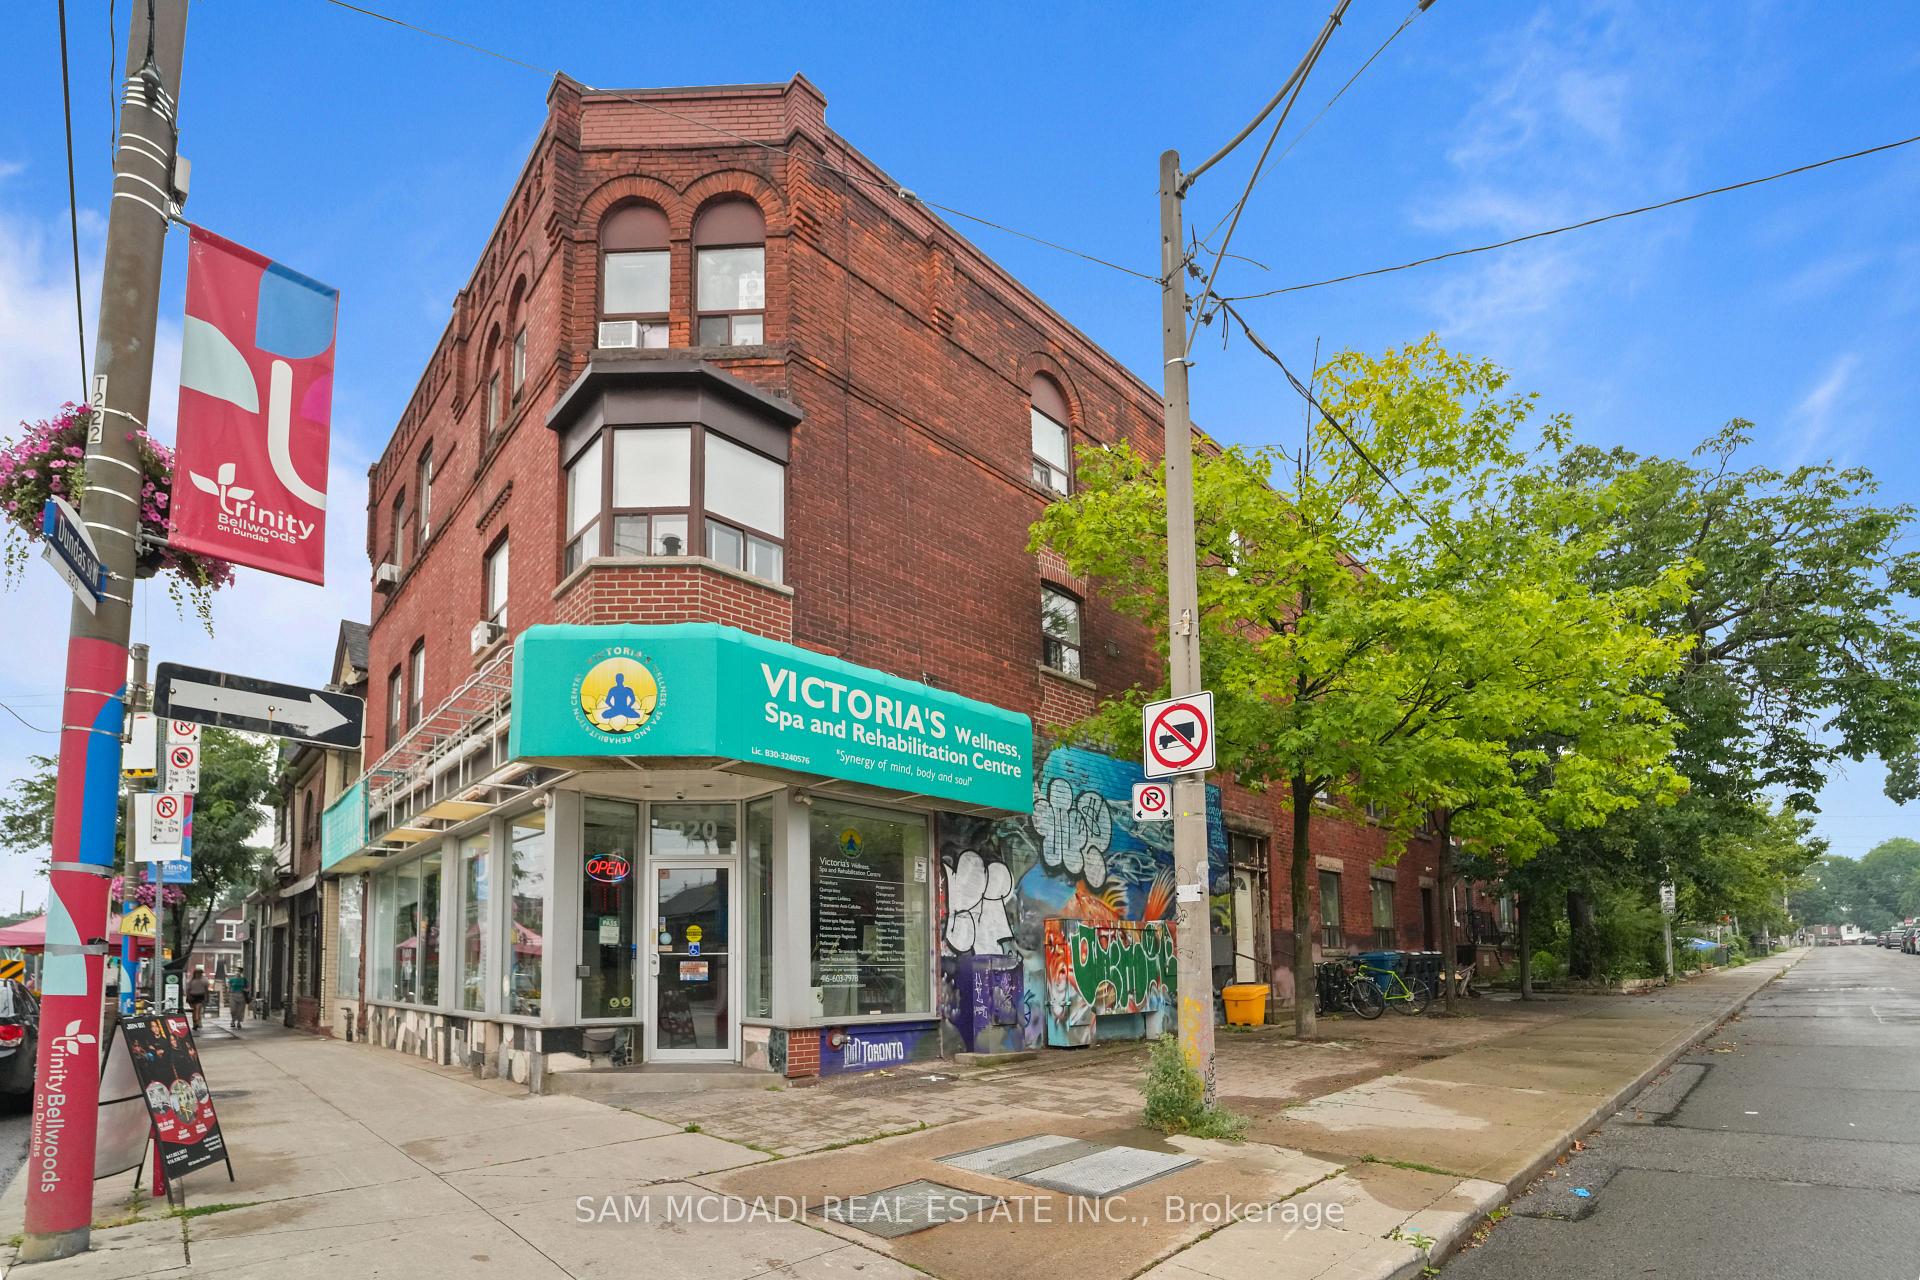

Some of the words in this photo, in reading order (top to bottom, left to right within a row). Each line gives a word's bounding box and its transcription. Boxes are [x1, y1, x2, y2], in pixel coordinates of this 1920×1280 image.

[217, 524, 230, 533] on
[233, 527, 269, 543] Dundas
[218, 512, 297, 545] Bellwoods
[58, 514, 87, 572] Dundas
[760, 662, 946, 739] VICTORIA'S
[955, 725, 1021, 761] Wellness,
[765, 702, 805, 731] Spa
[810, 718, 846, 739] and
[853, 722, 968, 767] Rehabilitation
[972, 752, 1022, 778] Centre
[878, 759, 889, 772] of
[890, 762, 913, 777] mind,
[916, 766, 936, 782] body
[938, 772, 953, 783] and
[588, 860, 626, 876] OPEN
[819, 857, 850, 868] Victoria's
[602, 919, 618, 927] PASS
[861, 1041, 904, 1064] TORONTO
[37, 1094, 44, 1109] on
[33, 1112, 45, 1158] Dundas
[41, 1094, 66, 1193] Bellwoods
